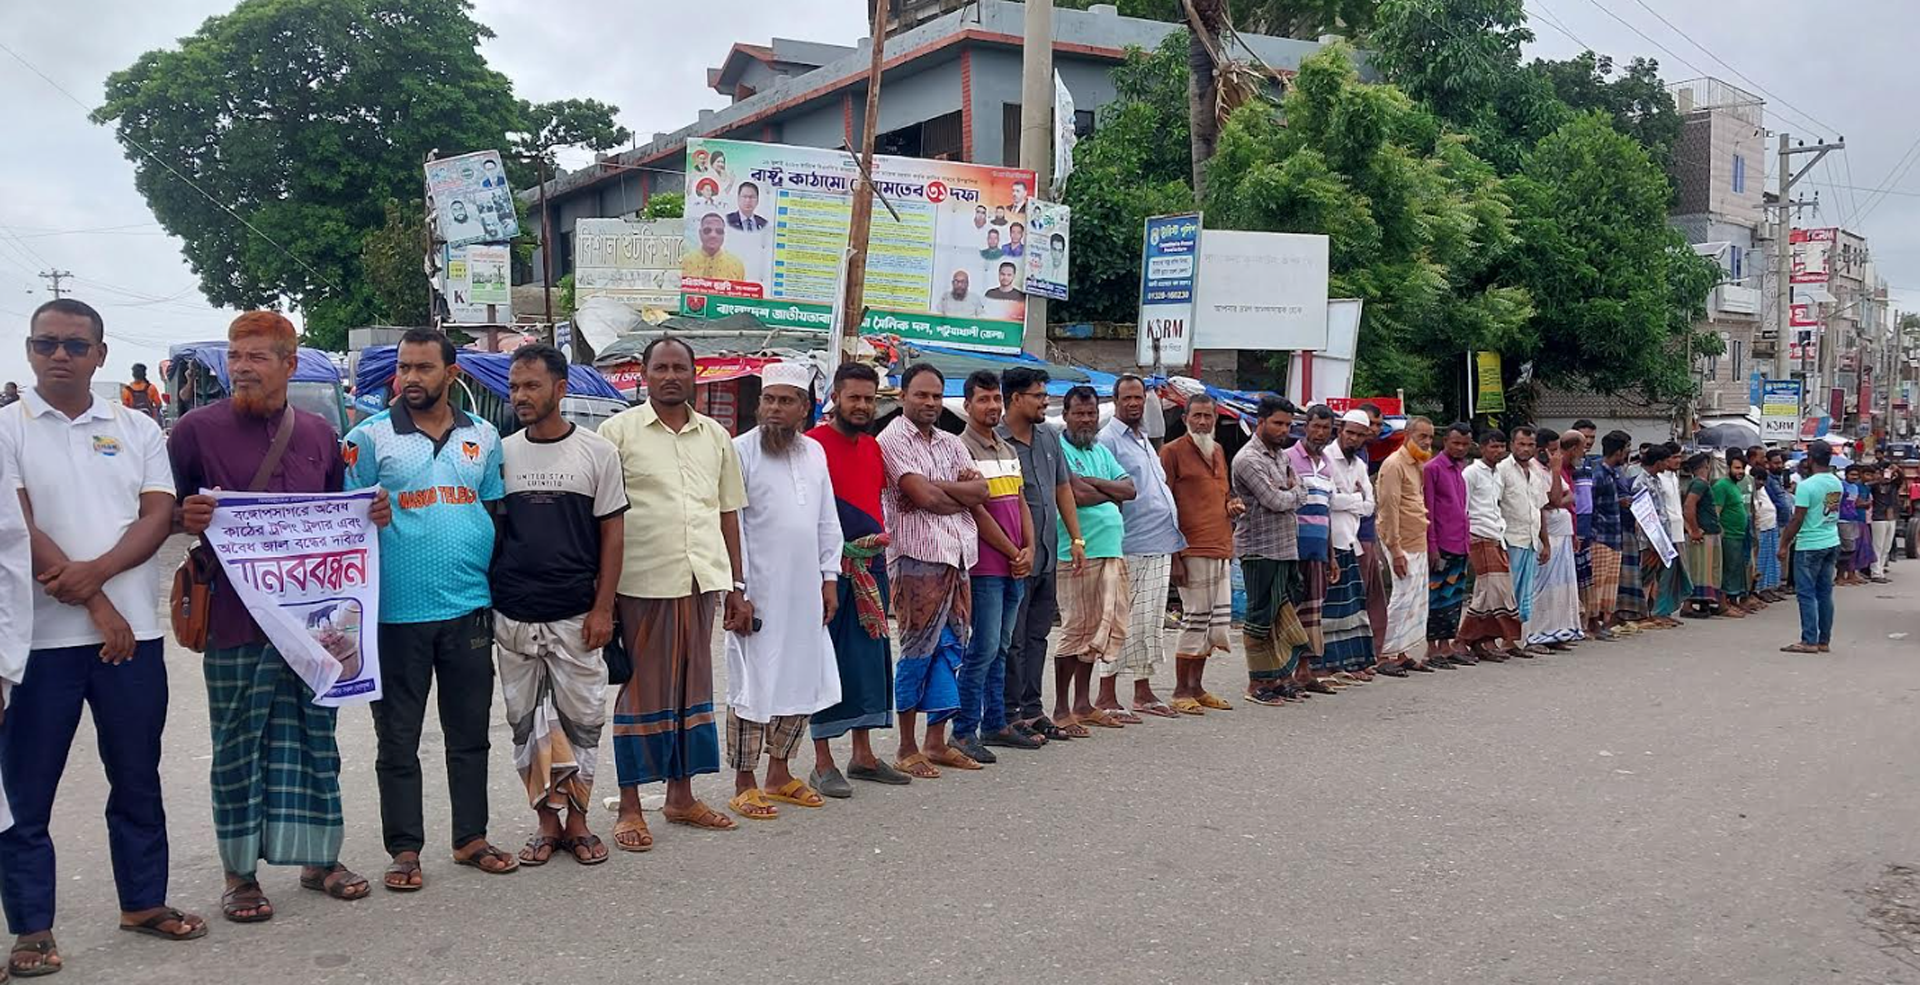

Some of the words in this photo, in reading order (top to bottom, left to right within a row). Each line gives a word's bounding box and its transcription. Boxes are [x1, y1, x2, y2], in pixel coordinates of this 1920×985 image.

[788, 171, 845, 191] কাঠামো
[927, 184, 947, 200] ৩১
[950, 190, 978, 204] দফা
[1147, 318, 1183, 340] KSRM
[231, 506, 310, 522] বঙ্গোপসাগরে
[221, 522, 266, 539] কাঠের
[261, 538, 290, 553] জাল
